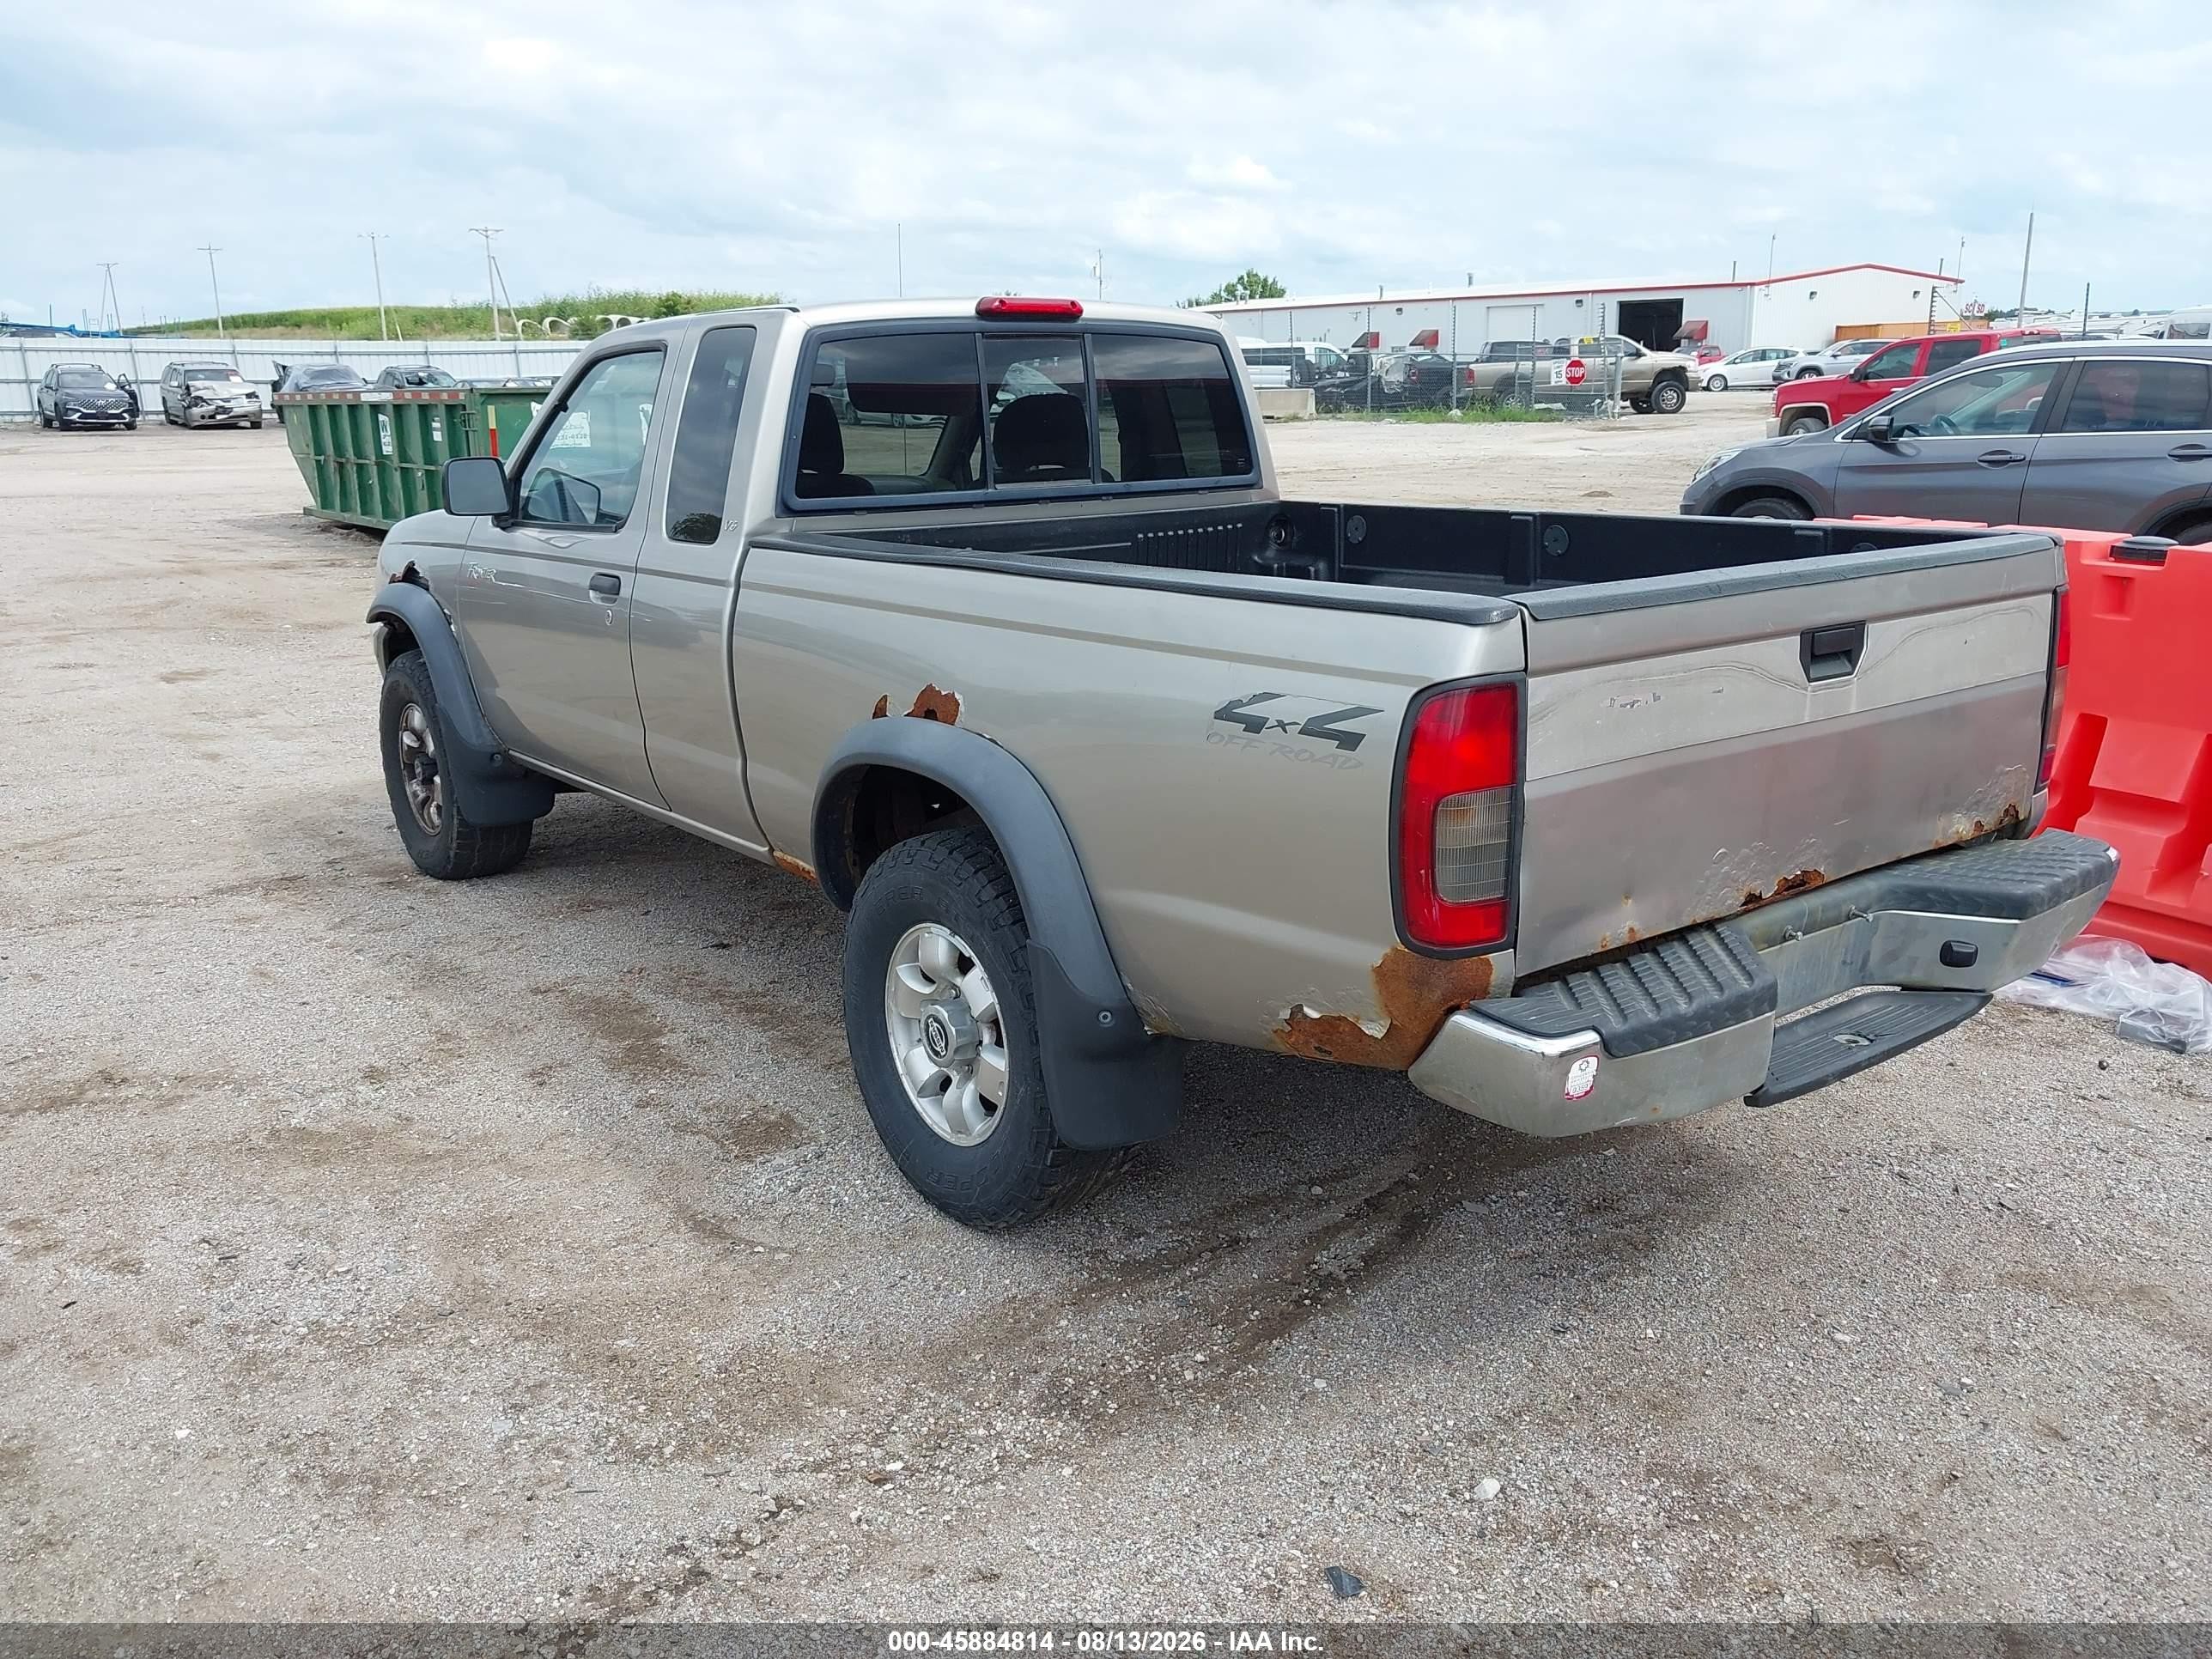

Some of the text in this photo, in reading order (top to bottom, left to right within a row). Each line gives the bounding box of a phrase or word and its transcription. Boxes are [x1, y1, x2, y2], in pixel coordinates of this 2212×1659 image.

[1555, 370, 1563, 379] 15
[1566, 367, 1585, 378] STOP
[928, 1018, 946, 1055] NISSAN
